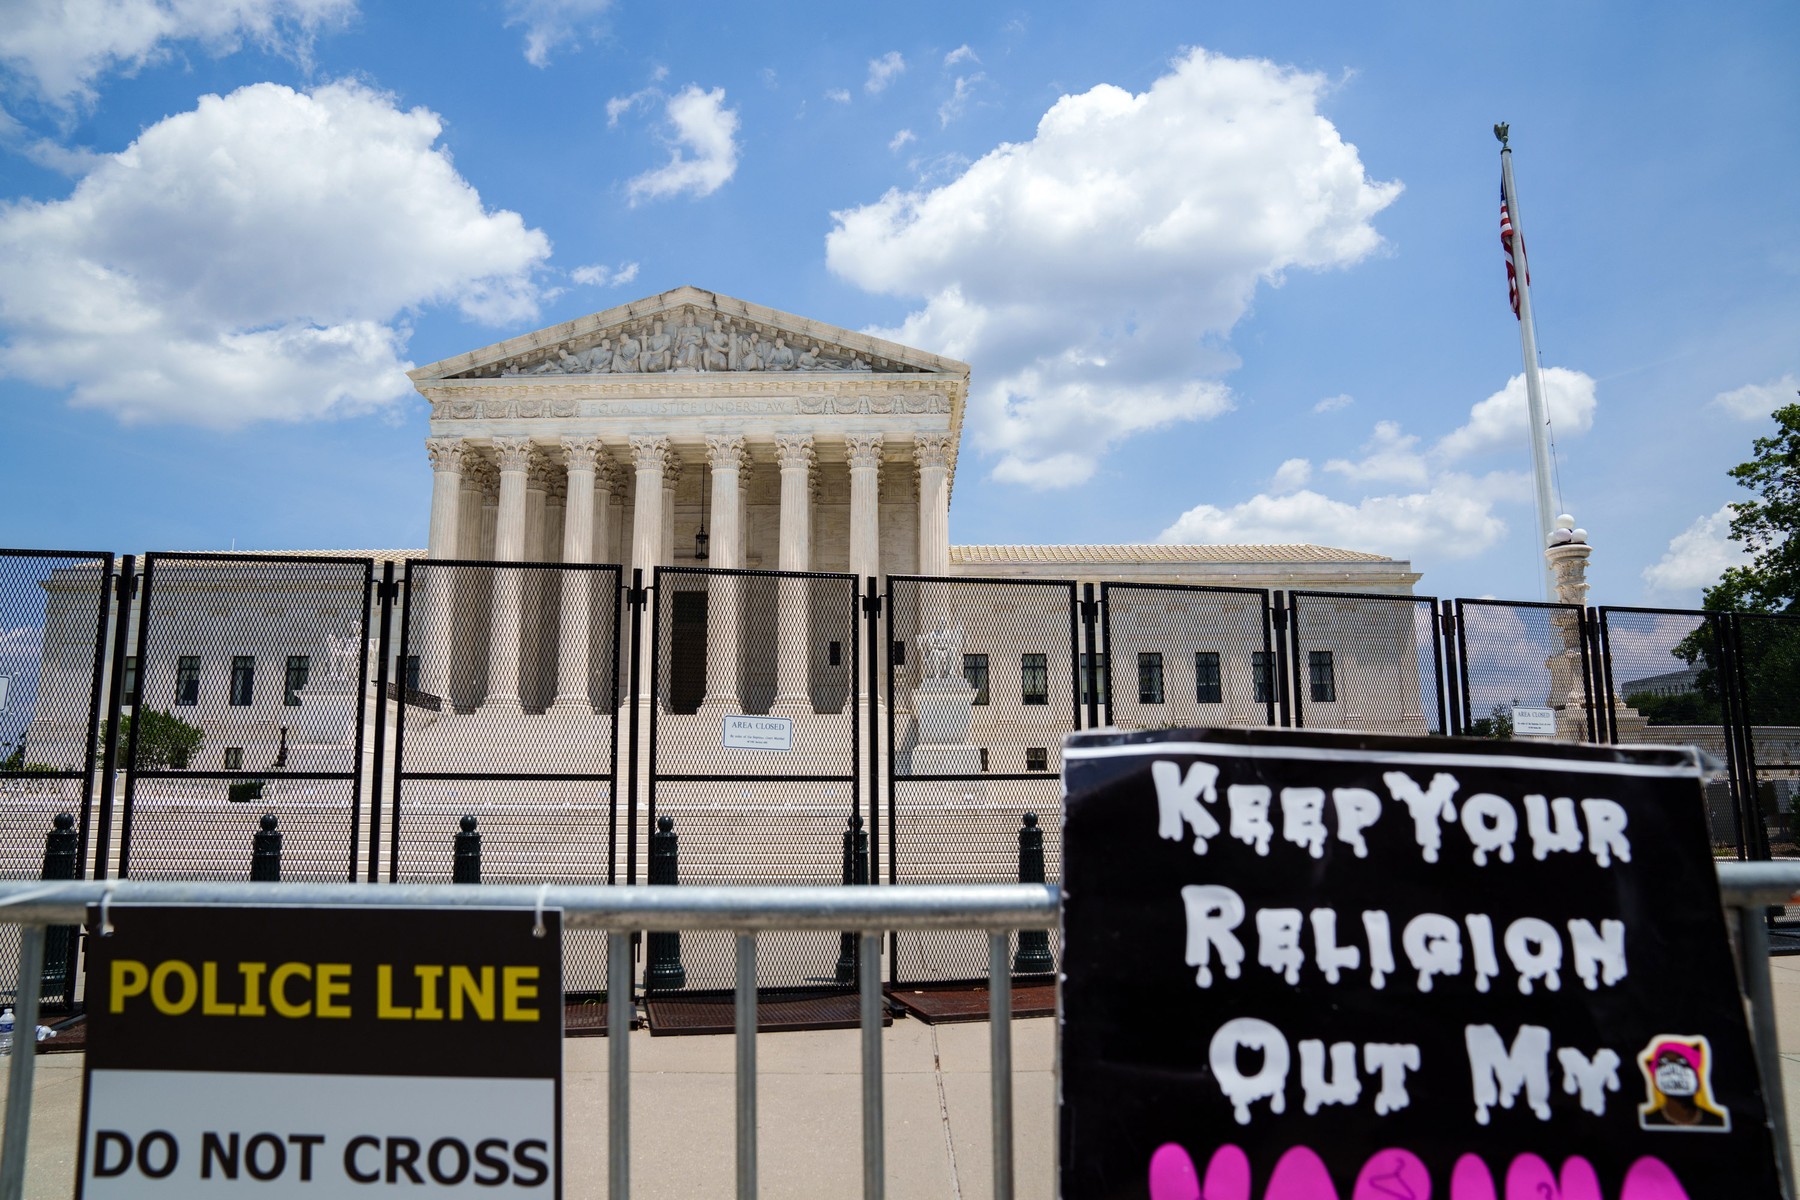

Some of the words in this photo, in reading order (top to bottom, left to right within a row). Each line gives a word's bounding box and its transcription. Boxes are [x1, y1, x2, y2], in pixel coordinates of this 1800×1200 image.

[590, 403, 640, 415] EQUAL
[642, 402, 697, 414] JUSTICE
[704, 402, 753, 413] UNDER
[757, 401, 785, 412] LAW
[1152, 761, 1382, 859] KEEP
[1383, 771, 1631, 868] YOUR
[1181, 884, 1628, 995] RELIGION
[109, 959, 352, 1019] POLICE
[376, 964, 541, 1022] LINE
[1209, 1017, 1421, 1125] OUT
[1465, 1024, 1621, 1125] MY
[92, 1129, 180, 1180] DO
[200, 1131, 326, 1182] NOT
[343, 1134, 549, 1188] CROSS
